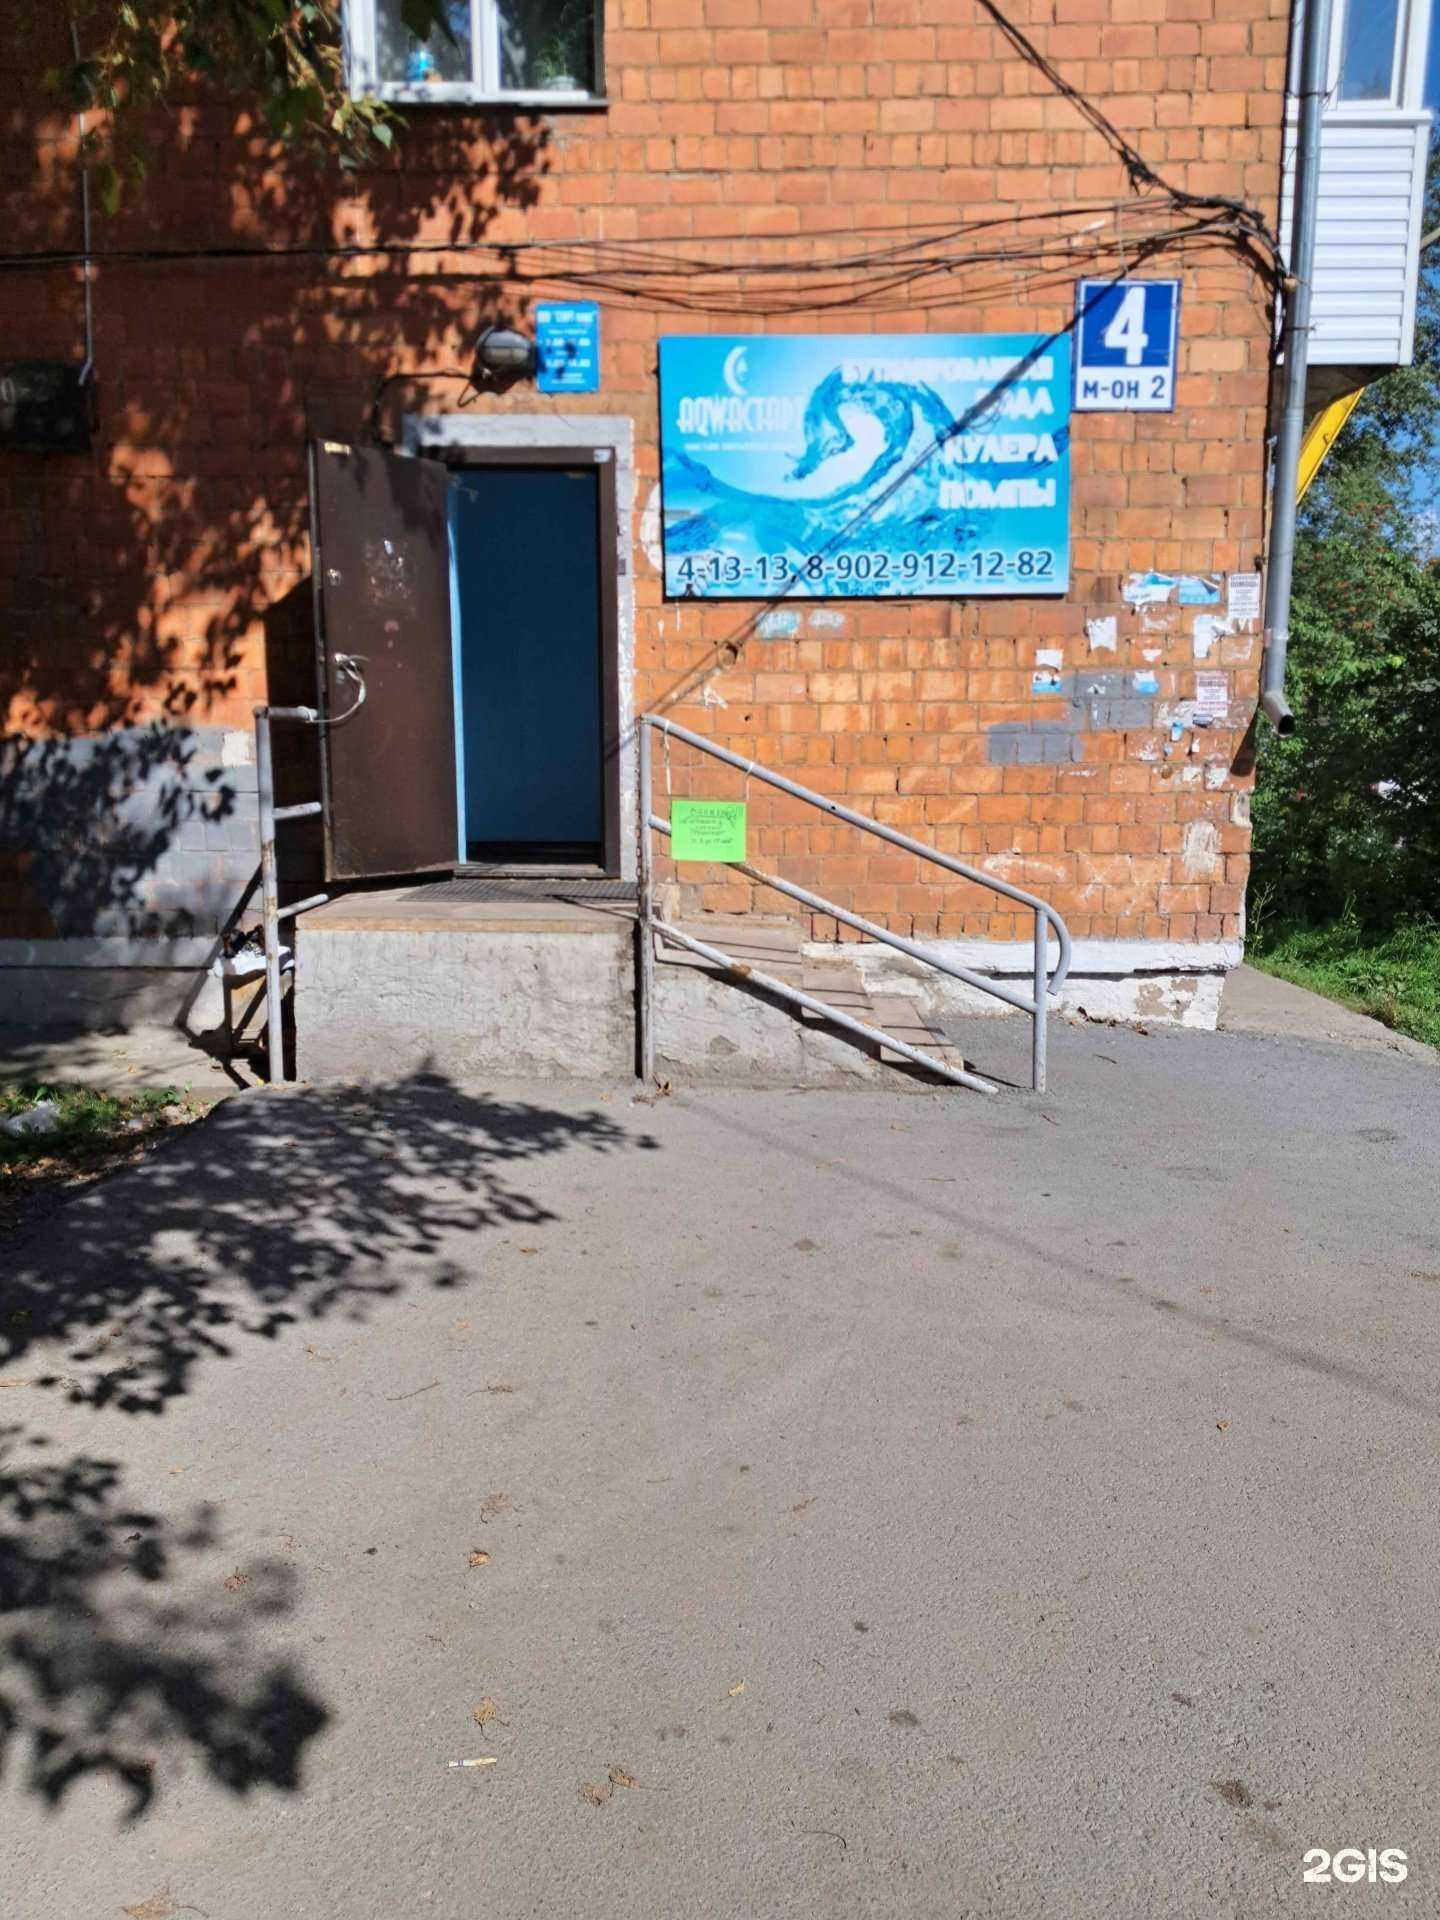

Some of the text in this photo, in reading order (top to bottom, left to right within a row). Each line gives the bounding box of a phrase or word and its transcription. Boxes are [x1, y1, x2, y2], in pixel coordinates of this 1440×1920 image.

[1104, 286, 1149, 366] 4
[1083, 374, 1166, 399] М-ОН 2
[943, 431, 1059, 464] КУЛЕРА
[938, 477, 1058, 509] ПОМПЫ
[807, 550, 1053, 581] 8-902-912-12-82
